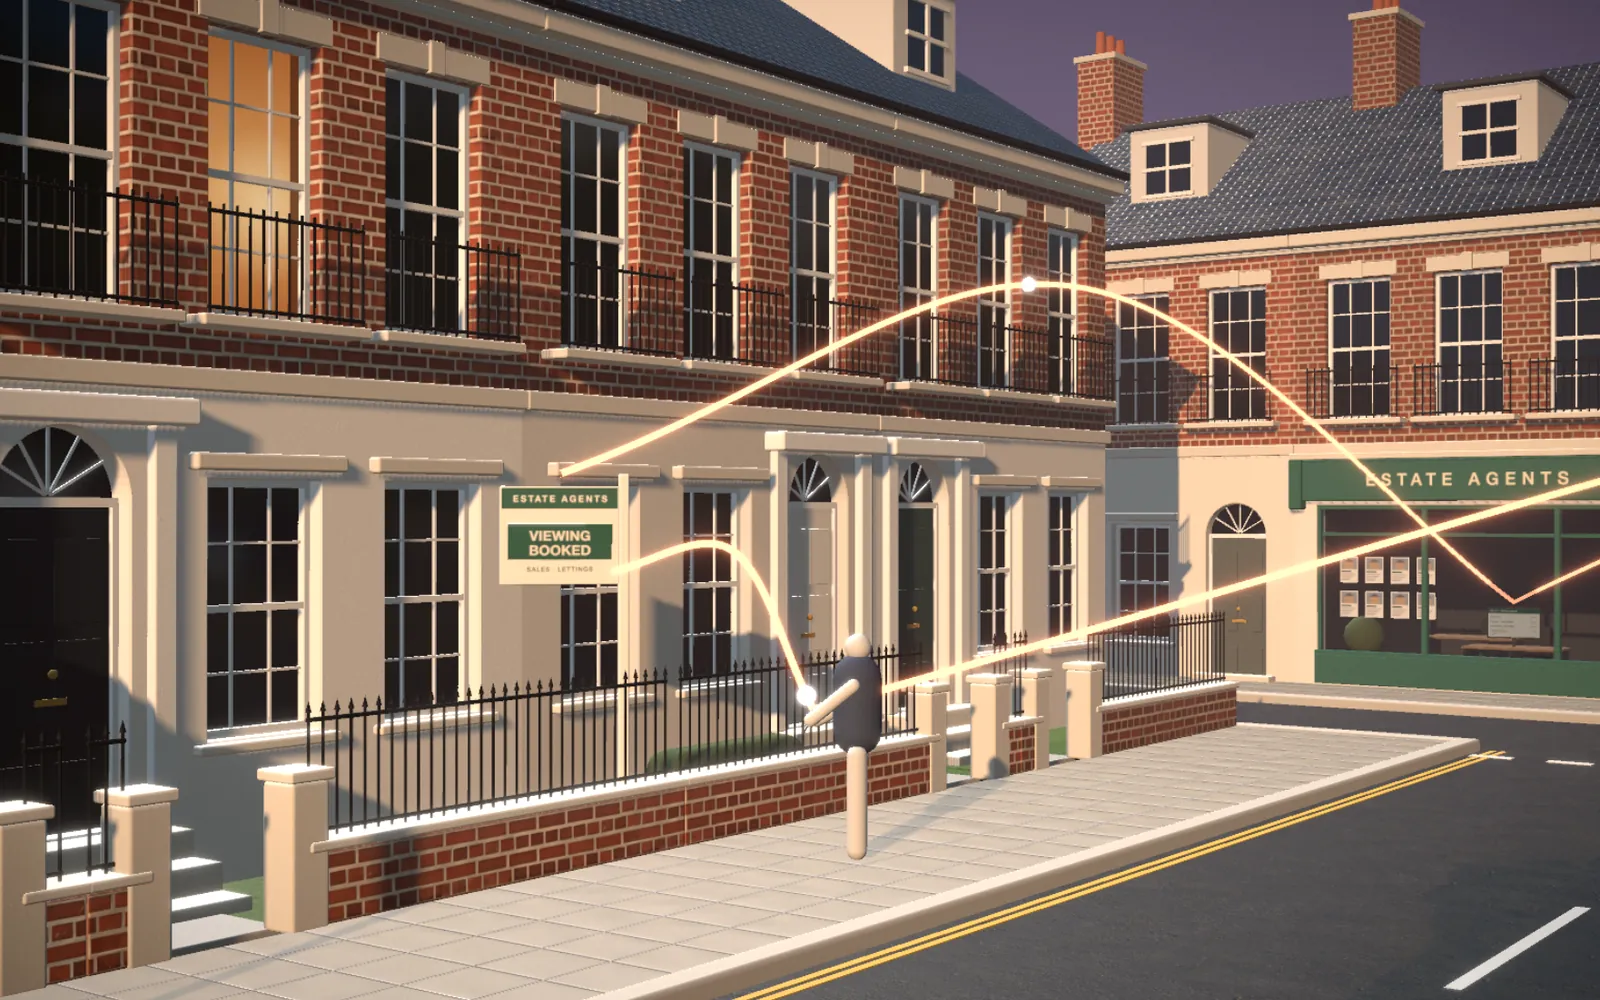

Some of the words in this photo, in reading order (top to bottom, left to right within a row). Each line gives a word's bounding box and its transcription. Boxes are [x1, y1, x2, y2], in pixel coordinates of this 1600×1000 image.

[1365, 471, 1453, 487] ESTATE
[1468, 470, 1570, 486] AGENTS
[512, 494, 556, 503] ESTATE
[561, 494, 608, 503] AGENTS
[529, 530, 591, 541] VIEWING
[529, 545, 591, 556] BOOKED
